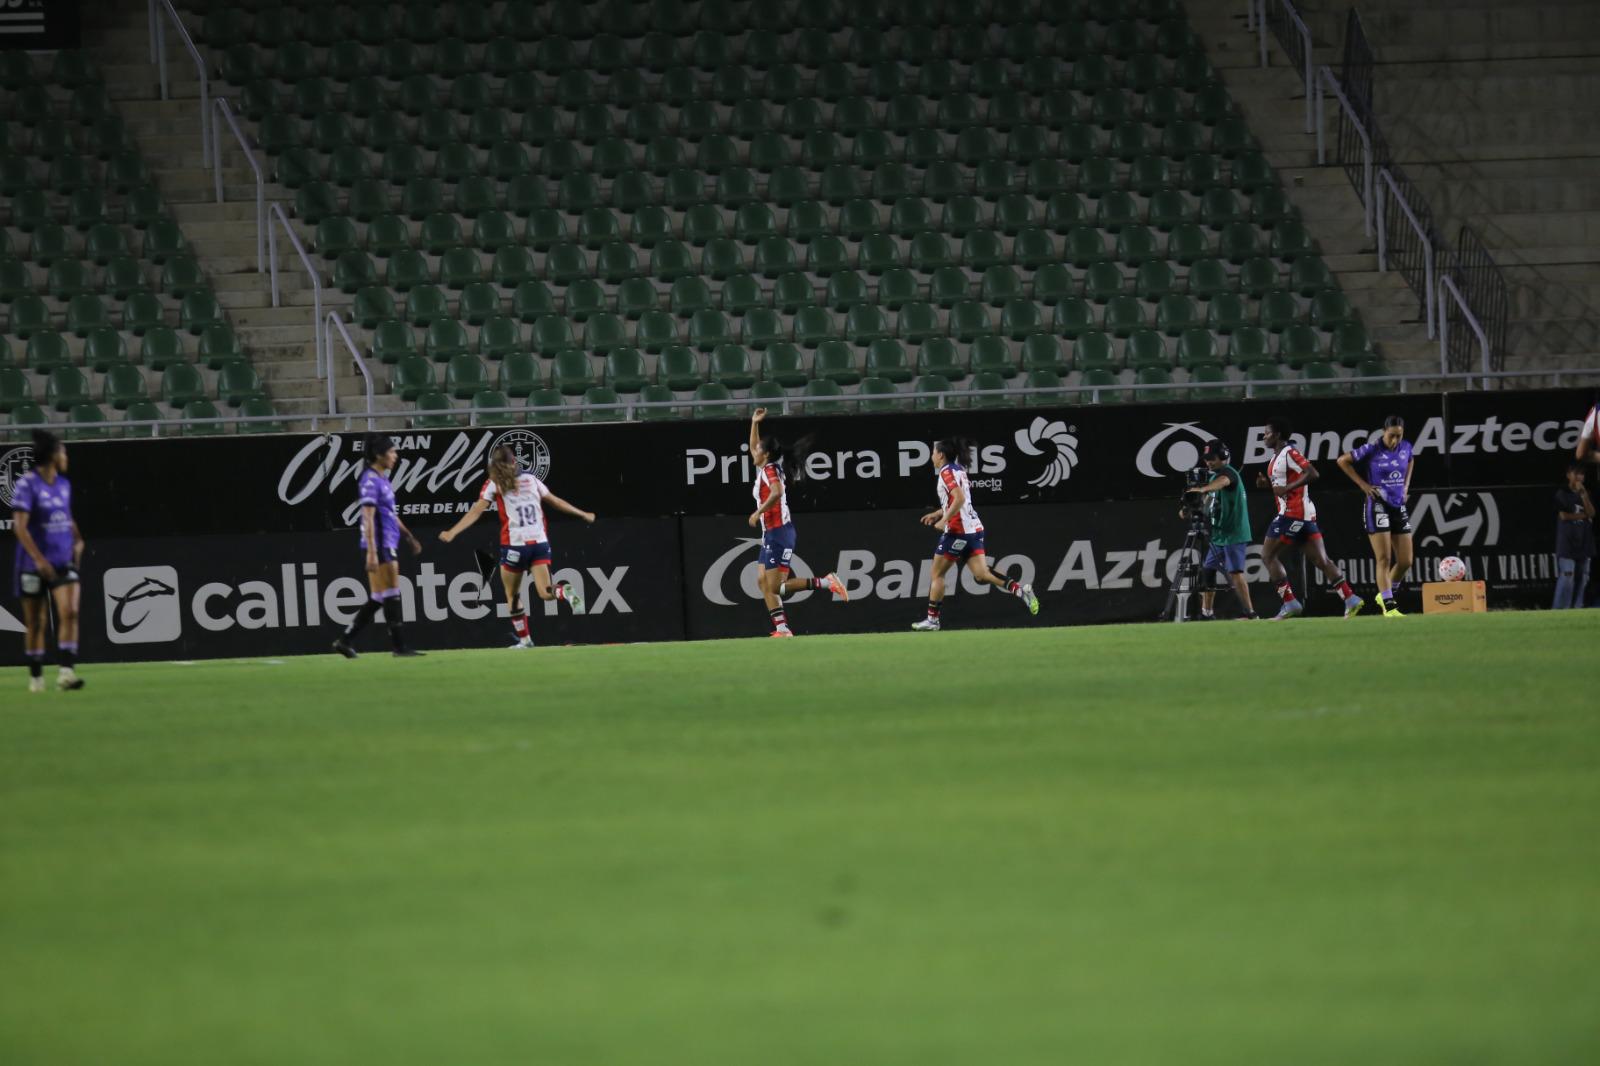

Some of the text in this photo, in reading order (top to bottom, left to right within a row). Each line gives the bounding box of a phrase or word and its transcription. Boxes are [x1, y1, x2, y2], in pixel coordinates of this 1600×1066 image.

[388, 434, 432, 450] RAN
[1242, 414, 1585, 464] Banc Azteca
[686, 443, 881, 485] Priera
[968, 478, 1002, 488] onecta
[402, 503, 430, 515] SER
[433, 502, 453, 513] DE
[832, 538, 1272, 601] Banco Aztea
[1315, 552, 1560, 585] OGULL ALEGA Y VALENT
[1434, 593, 1463, 601] amazon
